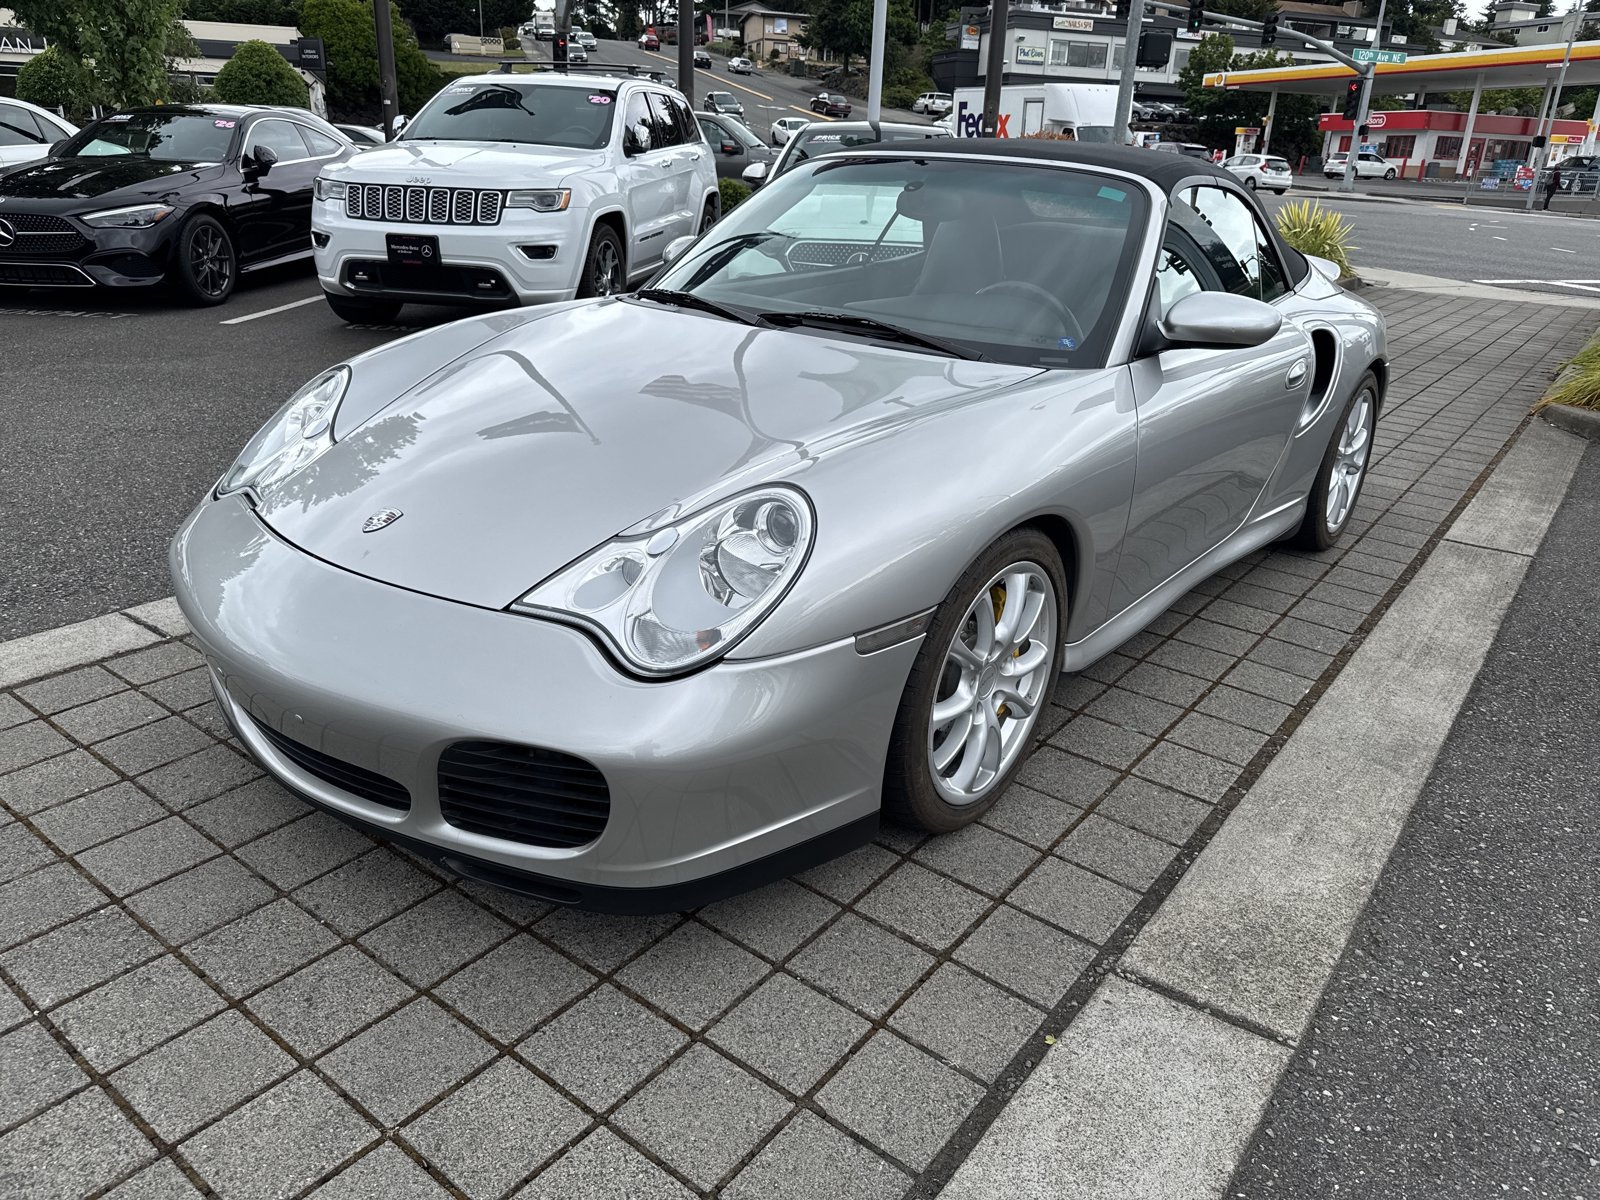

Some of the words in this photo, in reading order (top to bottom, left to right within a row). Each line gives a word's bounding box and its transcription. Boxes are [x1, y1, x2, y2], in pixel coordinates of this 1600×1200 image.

[1358, 51, 1374, 61] 120th
[1376, 52, 1389, 62] Ave
[1391, 54, 1402, 63] NE
[957, 101, 1011, 138] Fex
[405, 174, 432, 186] Jeep
